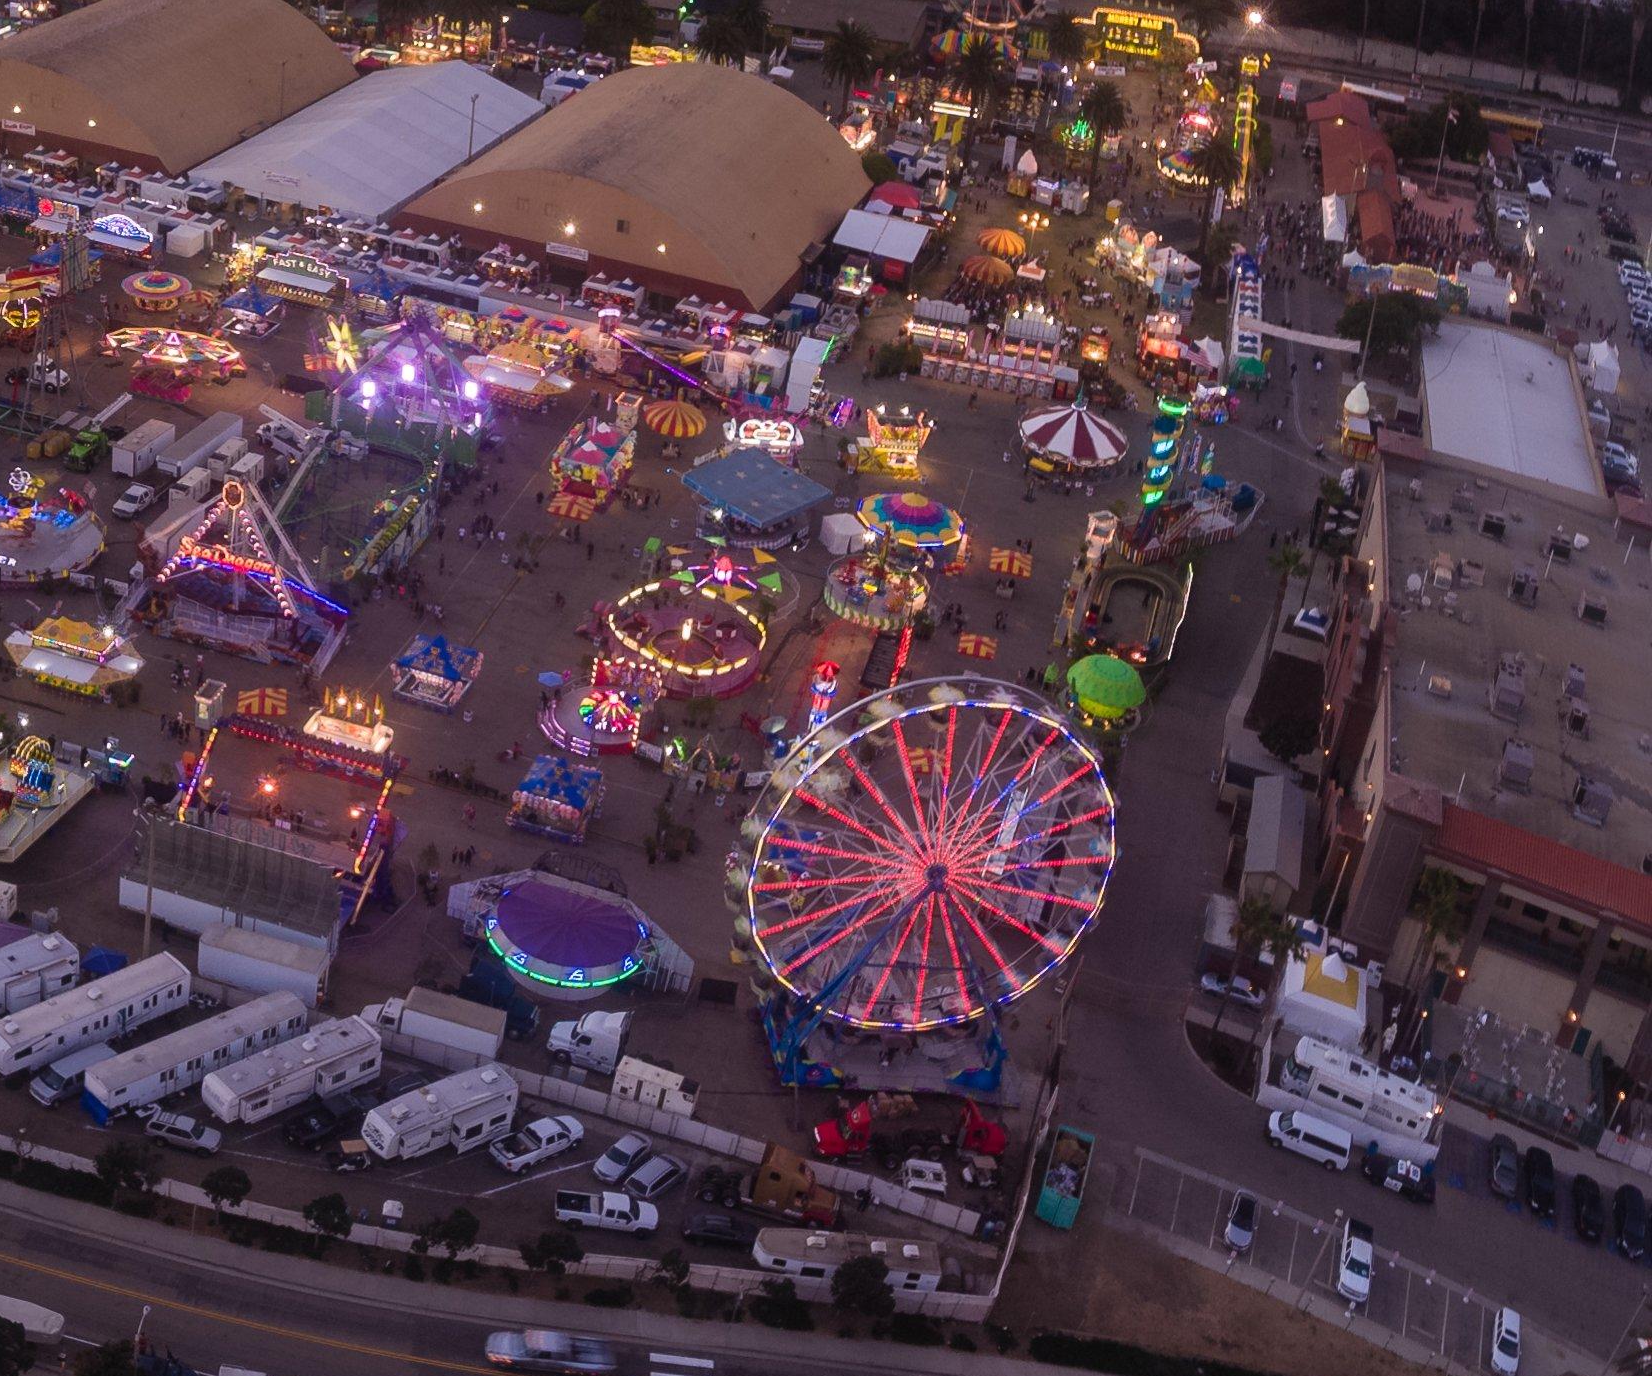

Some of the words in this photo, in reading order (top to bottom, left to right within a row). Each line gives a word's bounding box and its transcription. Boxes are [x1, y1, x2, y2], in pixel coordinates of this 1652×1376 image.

[272, 258, 297, 268] FAST
[306, 263, 332, 279] EASY
[180, 535, 212, 560] Sea
[212, 543, 276, 575] Dragon
